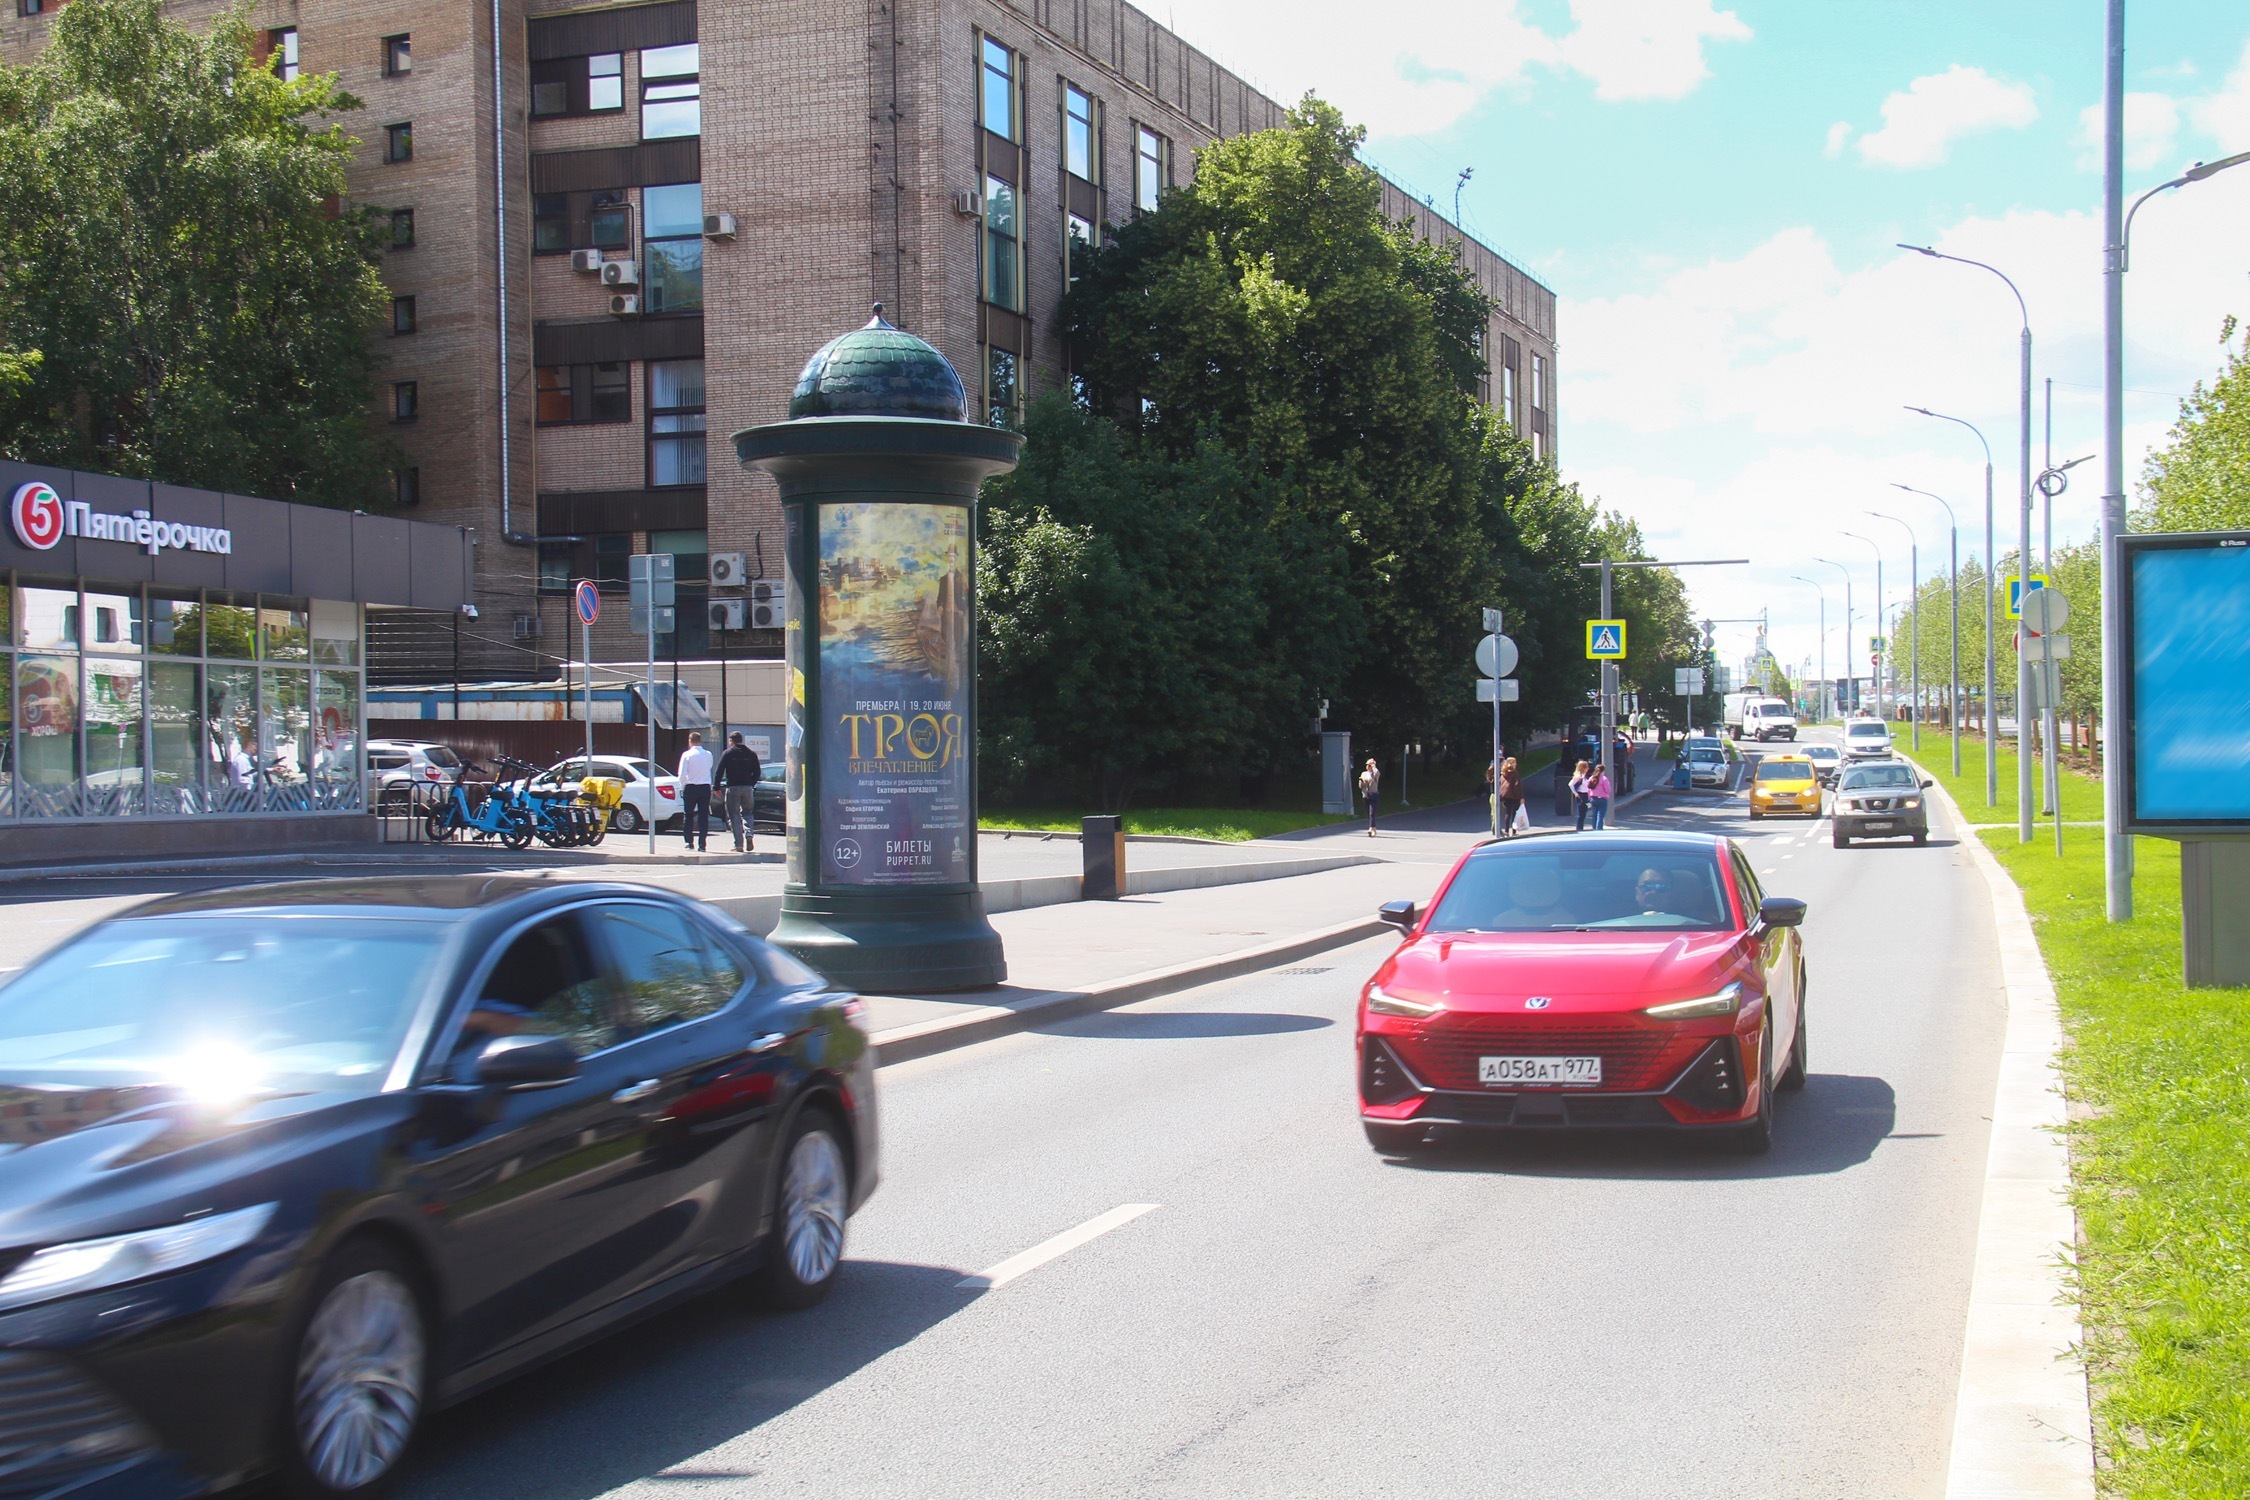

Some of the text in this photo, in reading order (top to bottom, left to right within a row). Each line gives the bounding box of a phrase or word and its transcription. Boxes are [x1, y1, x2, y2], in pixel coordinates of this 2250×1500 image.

[65, 500, 232, 555] Пятёрочка
[855, 700, 900, 711] ПРЕМЬЕРА
[923, 700, 933, 711] 20
[933, 700, 952, 711] ИЮНЯ
[839, 713, 963, 768] ТРОЯ
[848, 759, 938, 775] ВПЕЧАТЛЕНИЕ
[908, 786, 938, 794] ОБРАЗЦОВА
[886, 840, 932, 853] БИЛЕТЫ
[836, 847, 859, 860] 12+
[886, 855, 932, 866] PUPPET.RU
[1565, 1059, 1595, 1074] 977
